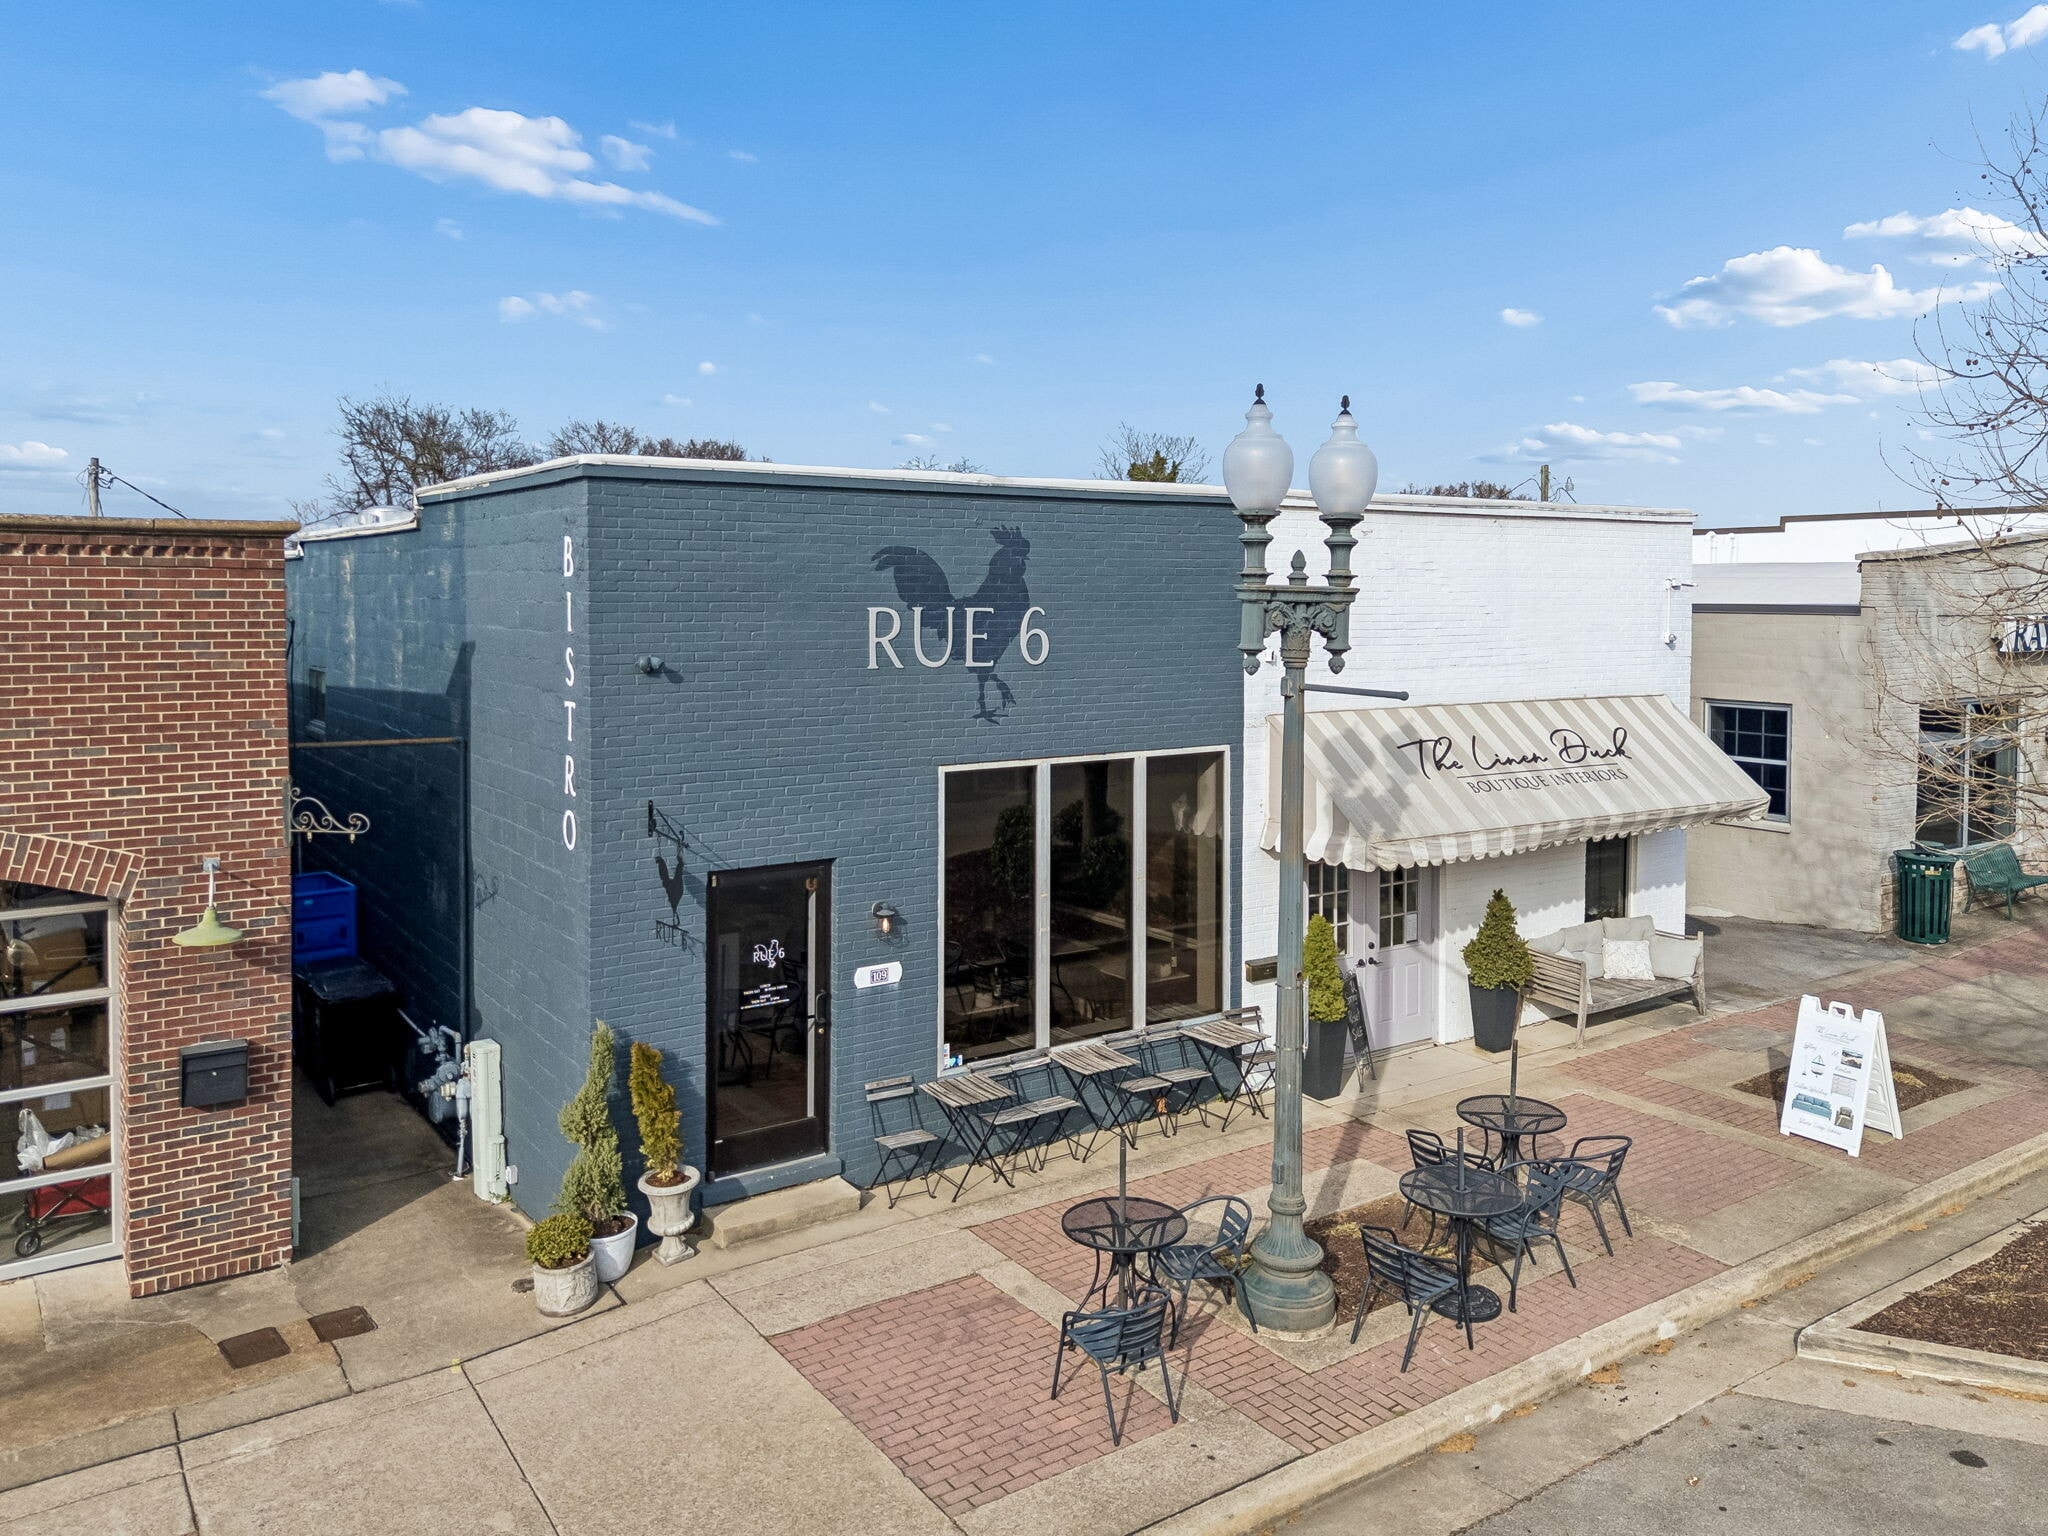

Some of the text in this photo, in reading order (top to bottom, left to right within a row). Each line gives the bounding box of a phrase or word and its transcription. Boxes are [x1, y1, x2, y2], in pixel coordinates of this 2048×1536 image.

[867, 606, 1050, 669] RUE 6
[2013, 615, 2048, 652] RA
[562, 535, 577, 851] BISTRO
[1397, 726, 1632, 780] The Linen Duck
[1466, 768, 1629, 794] BOUTIQUE INTERIORS
[655, 920, 677, 947] RUE
[753, 947, 786, 963] RUE 6
[873, 970, 887, 983] 109
